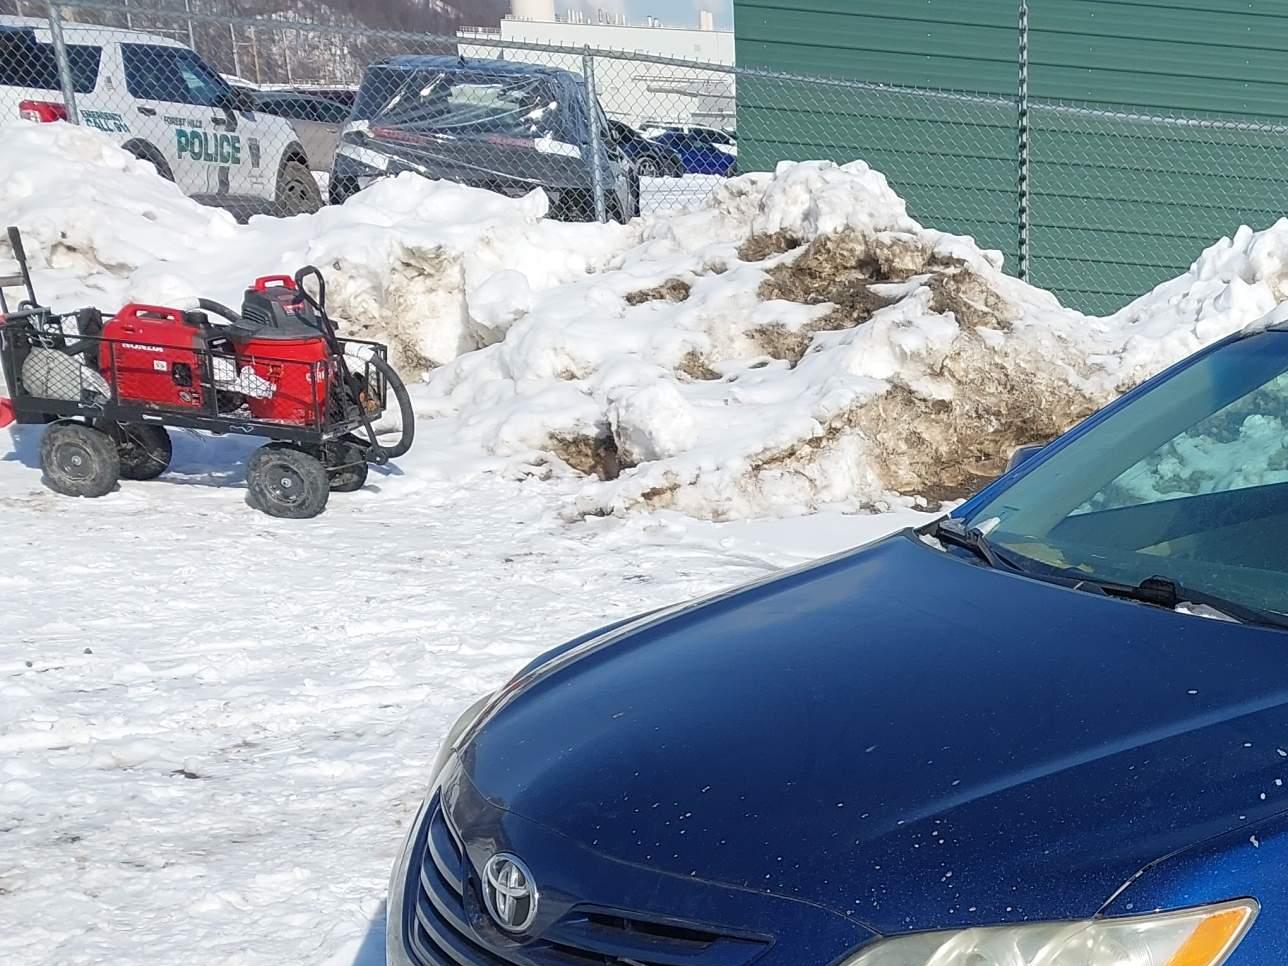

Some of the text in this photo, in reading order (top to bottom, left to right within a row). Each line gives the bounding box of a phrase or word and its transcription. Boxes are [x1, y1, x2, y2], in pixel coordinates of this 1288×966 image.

[85, 118, 131, 134] CALL 911
[163, 115, 186, 126] FOREST
[175, 128, 241, 164] POLICE
